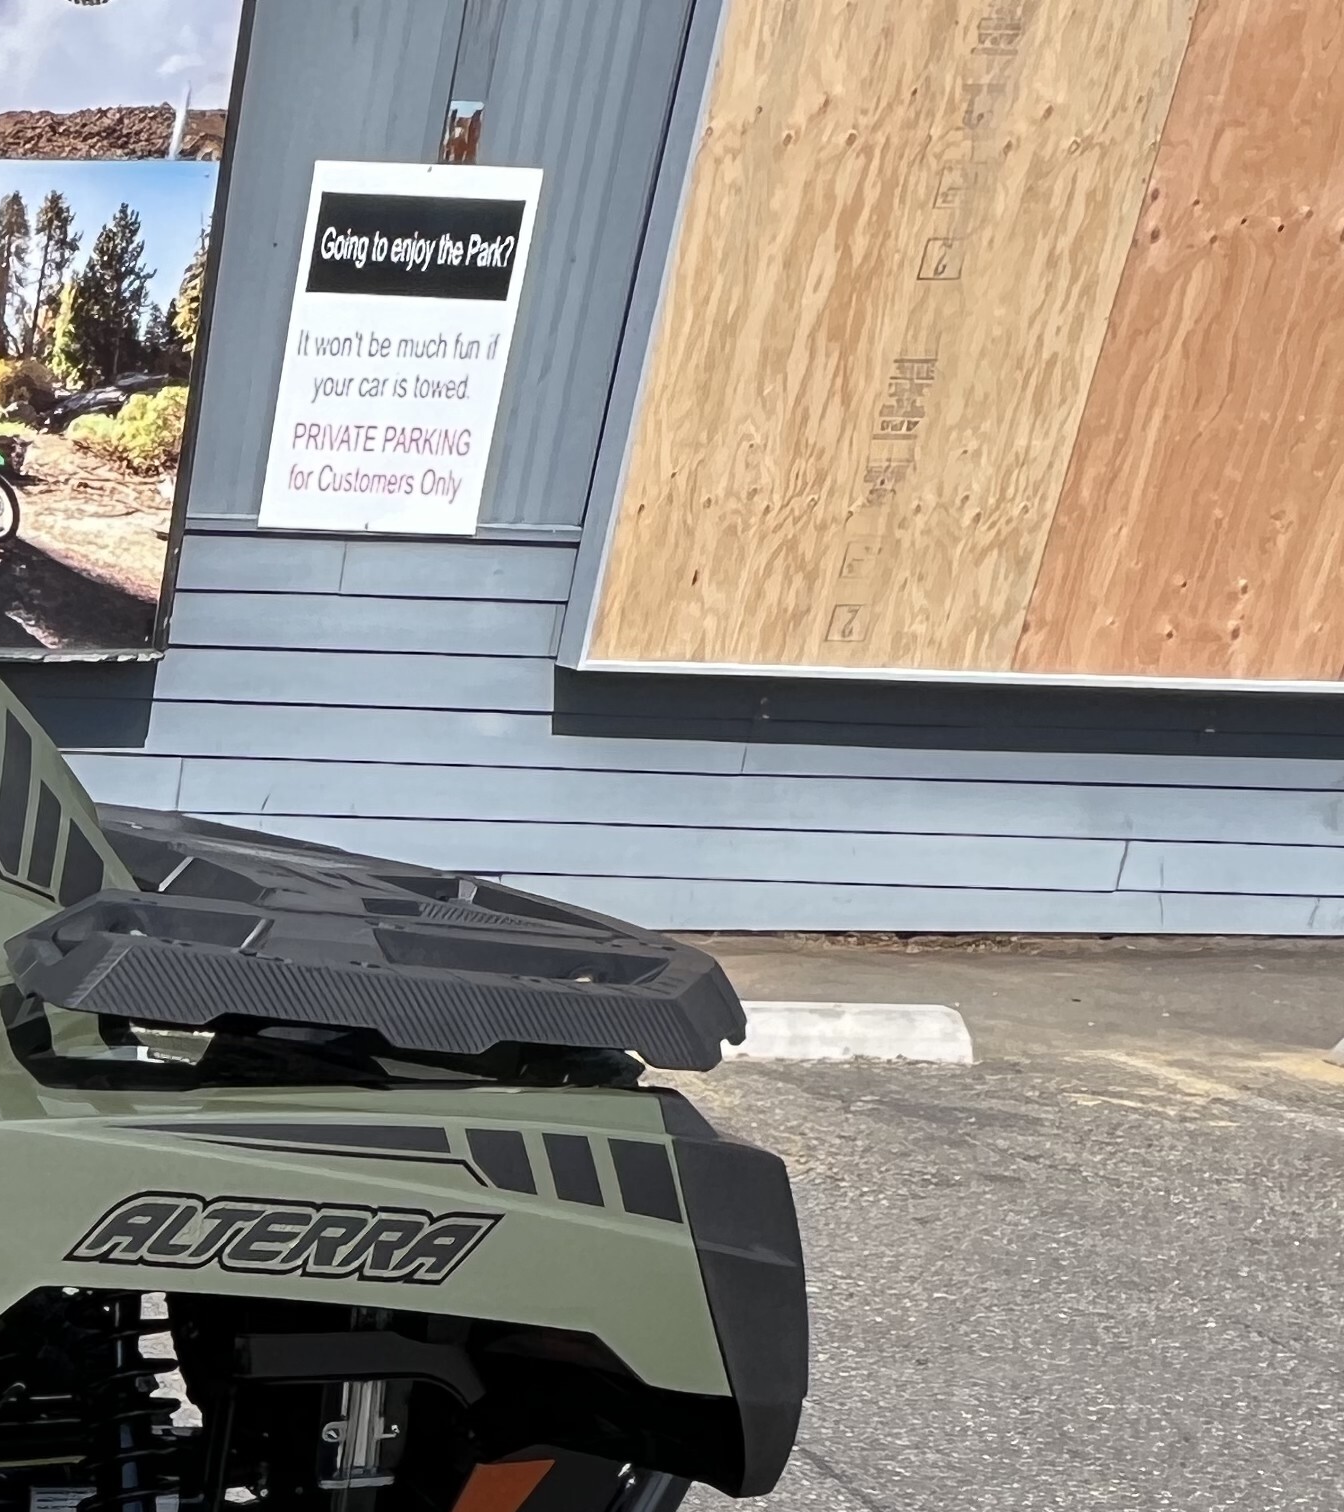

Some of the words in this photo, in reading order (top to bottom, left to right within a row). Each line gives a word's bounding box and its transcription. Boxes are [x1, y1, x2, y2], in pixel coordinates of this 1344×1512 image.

[321, 226, 369, 269] Going
[372, 230, 388, 262] to
[391, 231, 437, 271] enjoy
[437, 233, 464, 266] the
[465, 234, 515, 268] Park?
[297, 329, 310, 356] It
[315, 331, 363, 358] won't
[368, 331, 391, 358] be
[397, 333, 447, 359] much
[453, 332, 480, 360] fun
[486, 333, 501, 360] if
[311, 376, 354, 404] your
[358, 377, 390, 397] car
[392, 372, 407, 398] is
[413, 373, 470, 400] towed.
[292, 422, 378, 452] PRIVATE
[382, 426, 472, 456] PARKING
[288, 463, 313, 490] for
[318, 464, 415, 495] Customers
[420, 469, 463, 505] Only
[70, 1194, 499, 1282] ALTERRA
